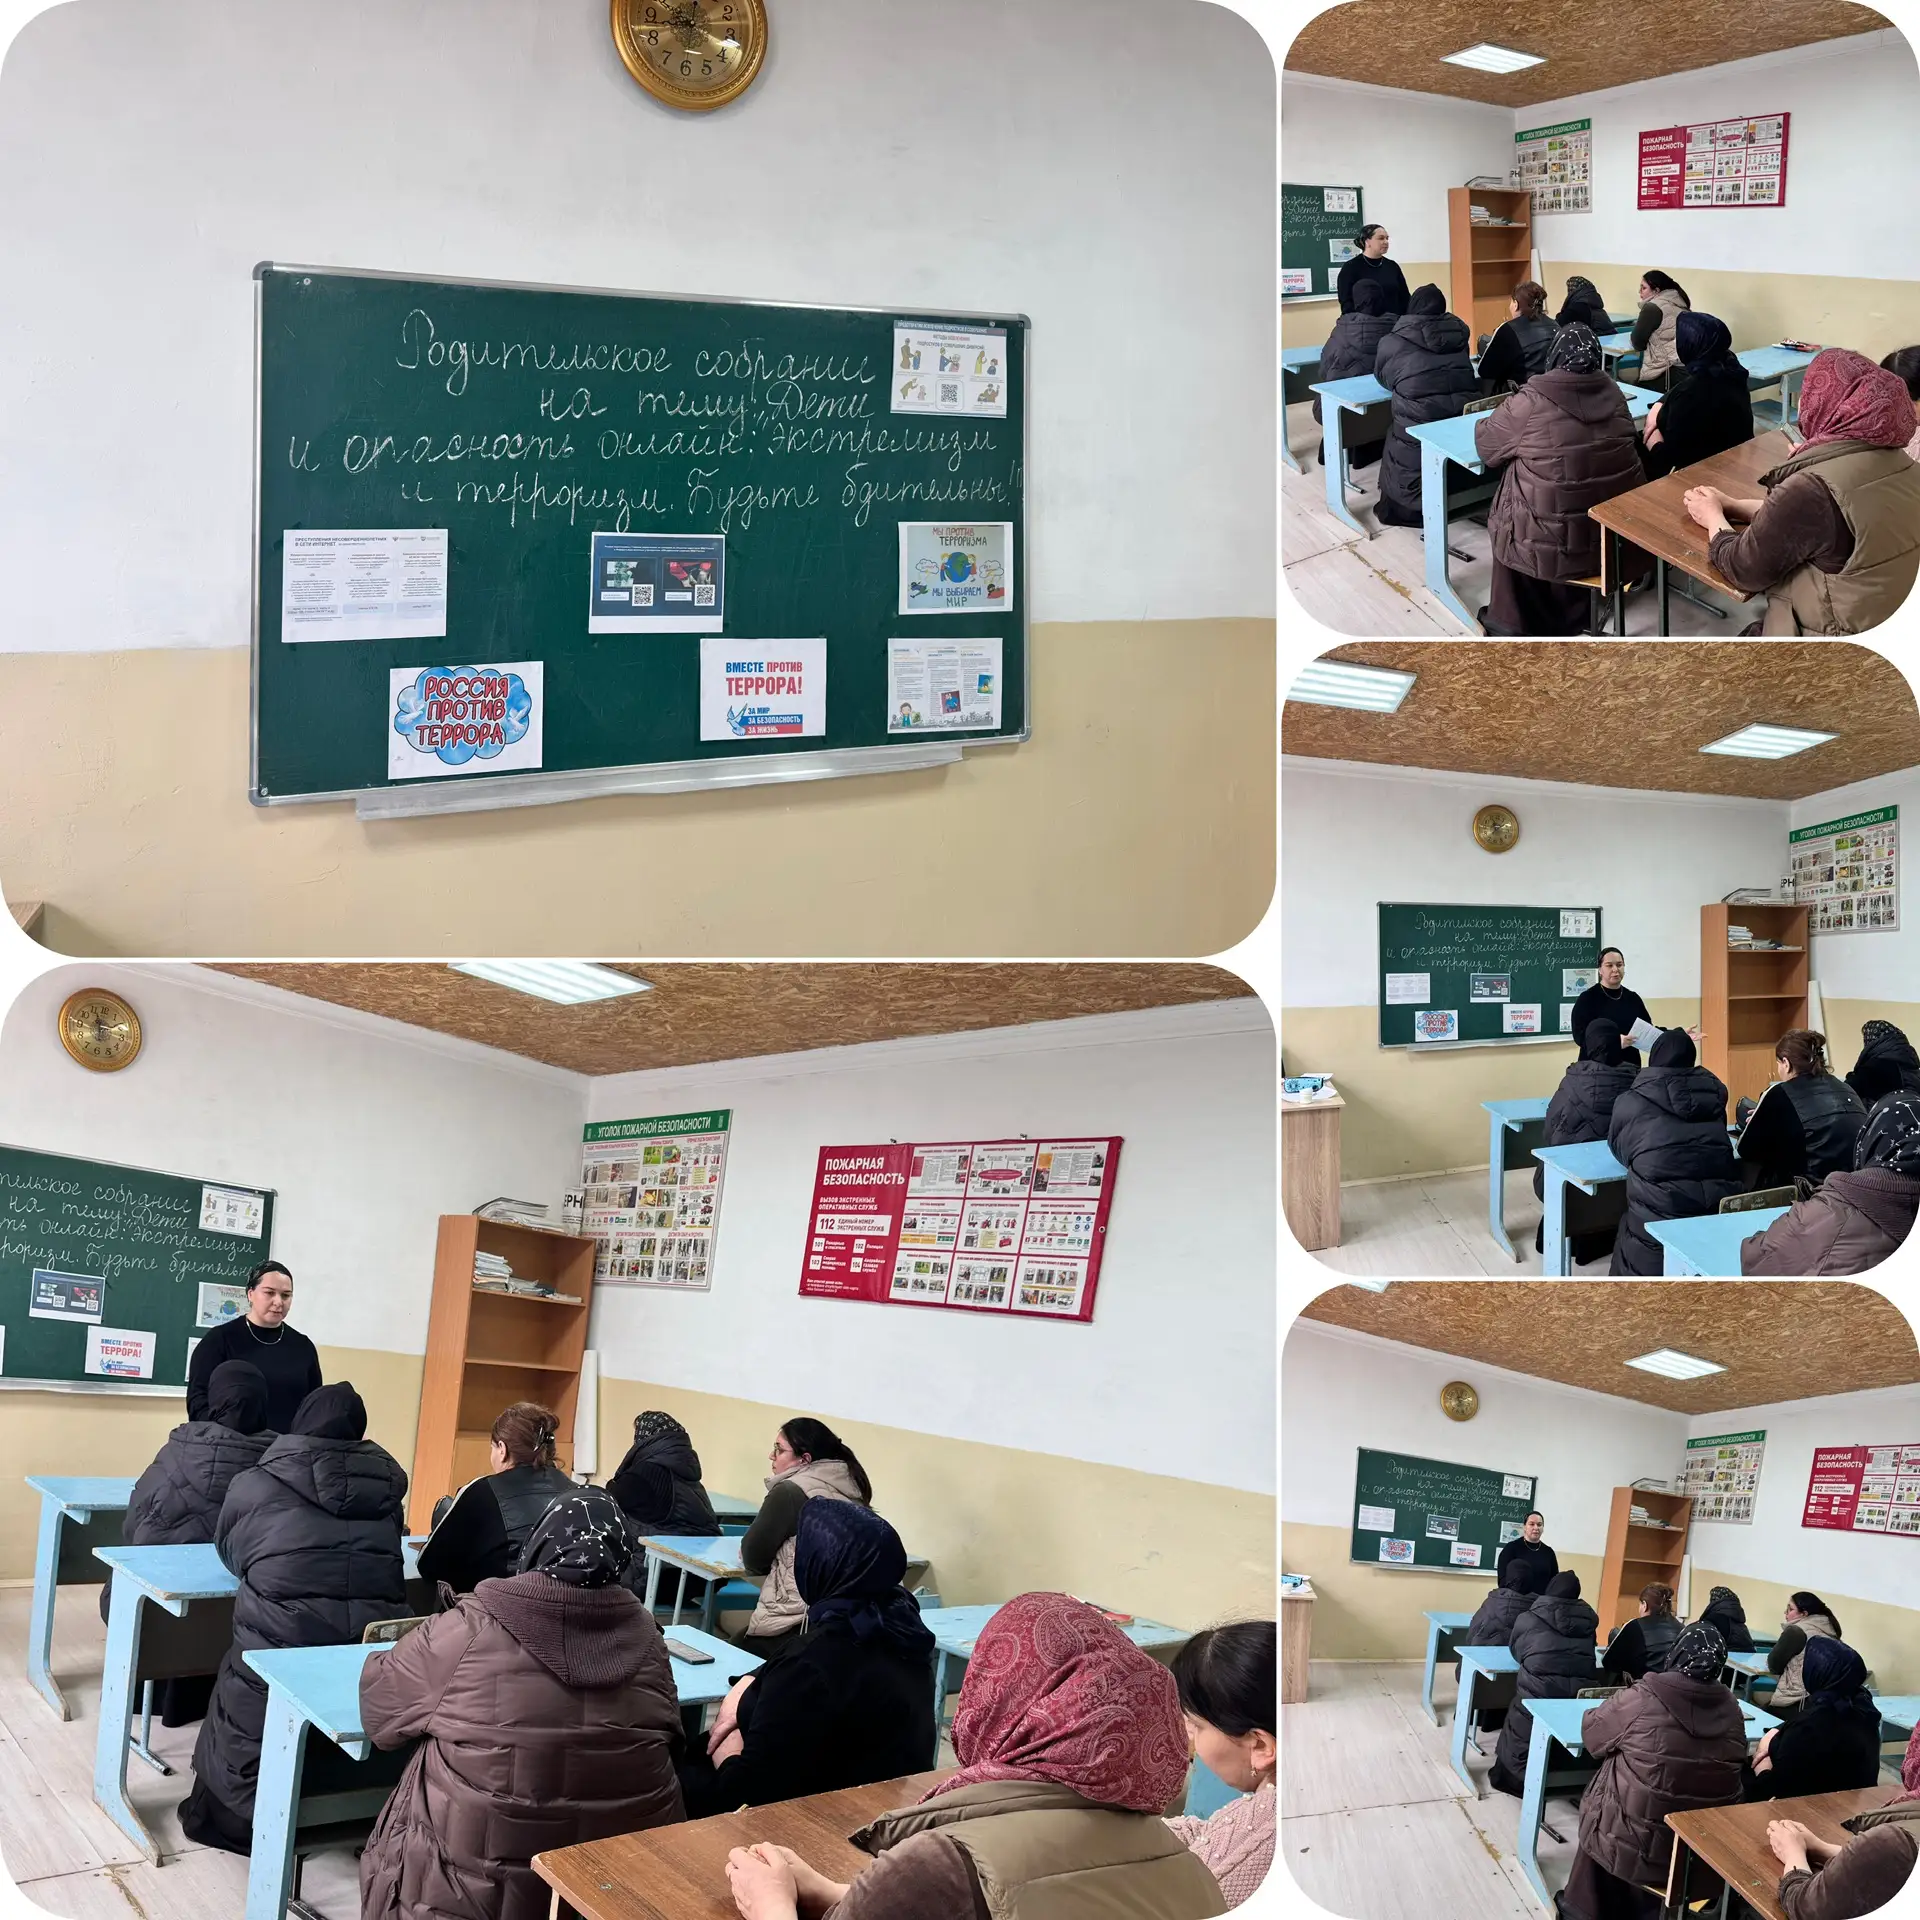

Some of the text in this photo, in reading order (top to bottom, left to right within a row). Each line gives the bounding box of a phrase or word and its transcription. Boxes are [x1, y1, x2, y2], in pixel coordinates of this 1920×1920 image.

[647, 29, 659, 46] 8
[661, 50, 672, 65] 7
[716, 47, 728, 63] 4
[680, 60, 692, 76] 6
[702, 59, 712, 76] 5
[396, 308, 673, 396] Родительское
[541, 388, 608, 421] на
[288, 435, 321, 471] и
[343, 432, 576, 474] опасность
[401, 481, 433, 503] и
[687, 467, 820, 534] Будьте
[939, 537, 988, 546] ТЕРРОРИЗМА
[932, 587, 982, 597] МЫ ВЫБИРАЕМ
[946, 597, 968, 607] МИР
[726, 661, 803, 673] ВМЕСТЕ ПРОТИВ
[424, 676, 509, 700] РОССИЯ
[725, 676, 803, 696] ТЕРРОРА!
[427, 699, 506, 723] ПРОТИВ
[748, 715, 801, 725] ЗА БЕЗОПАСНОСТЬ
[415, 723, 504, 748] ТЕРРОРА
[597, 1117, 711, 1138] УГОЛОК ПОЖАРНОЙ БЕЗОПАСНОСТИ
[825, 1157, 884, 1170] ПОЖАРНАЯ
[823, 1173, 905, 1185] БЕЗОПАСНОСТЬ
[9, 1196, 46, 1212] на
[820, 1218, 836, 1230] 112
[86, 1243, 158, 1277] Будьте
[100, 1345, 142, 1358] ТЕРРОРА!
